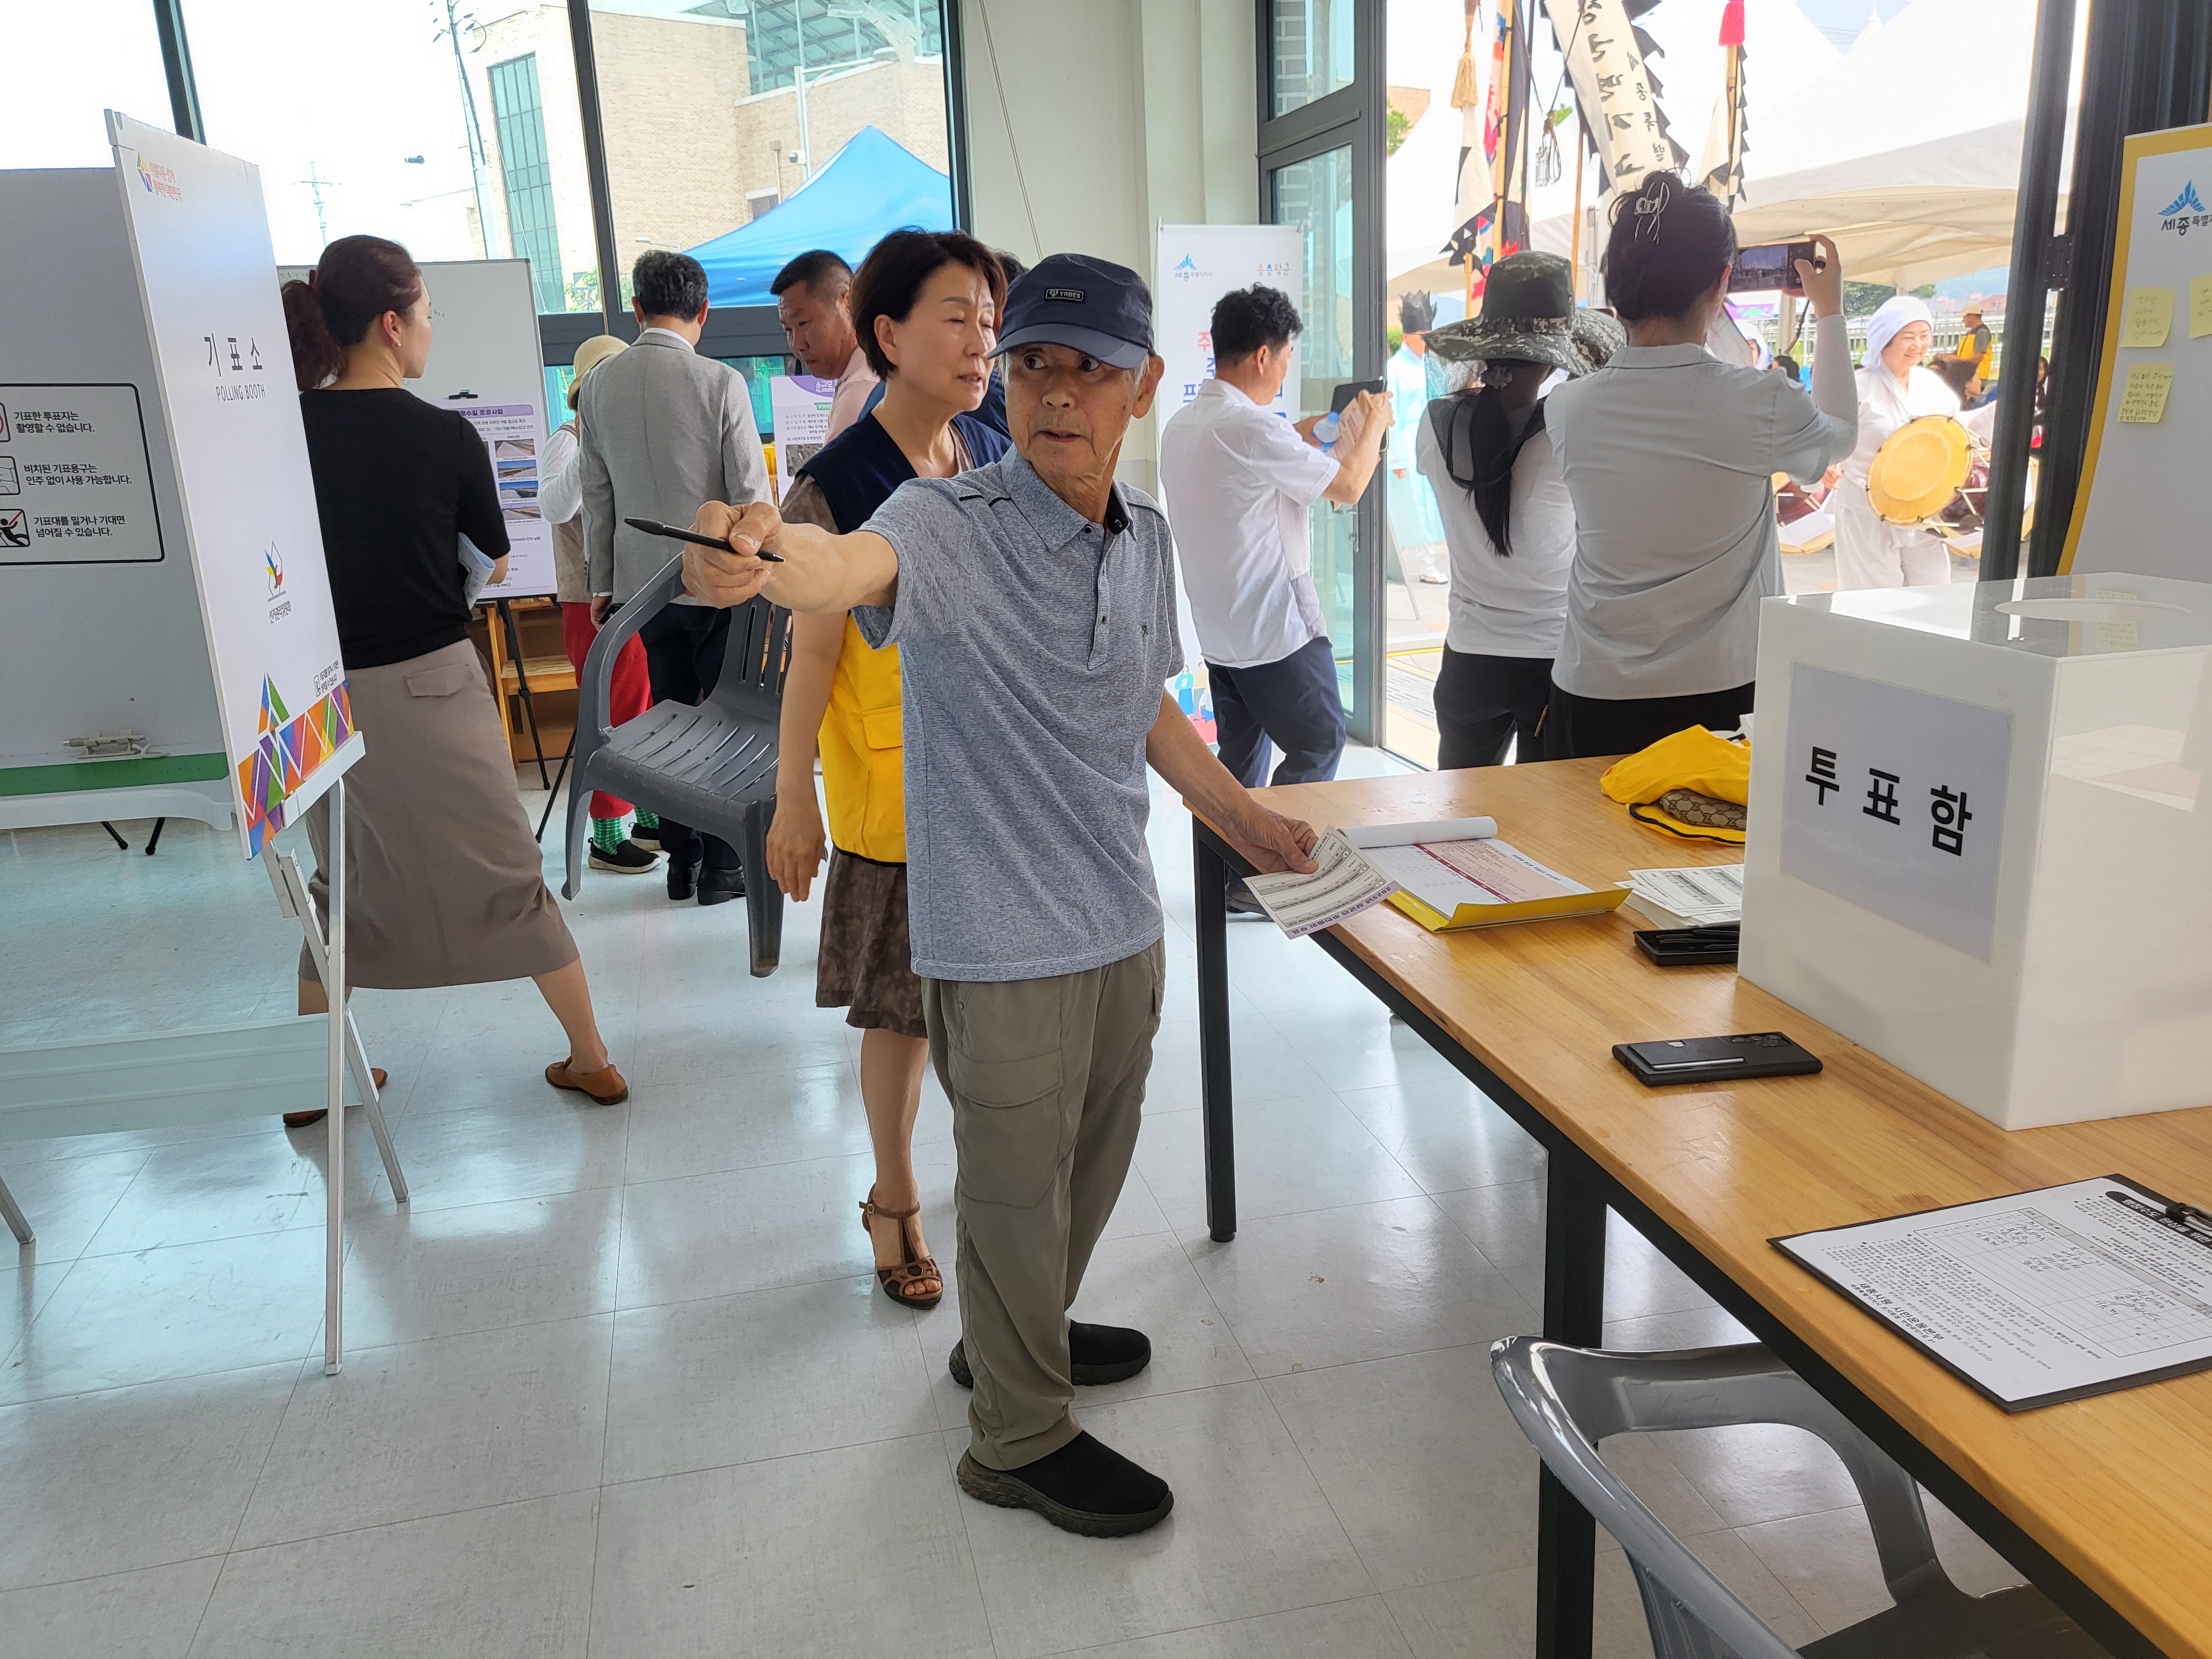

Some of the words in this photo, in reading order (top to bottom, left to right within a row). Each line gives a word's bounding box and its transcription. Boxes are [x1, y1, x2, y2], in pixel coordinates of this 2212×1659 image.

[150, 162, 167, 181] 아름다운
[166, 168, 176, 184] 선거
[153, 180, 167, 197] 행복한
[166, 184, 182, 202] 대한민국
[216, 384, 244, 401] POLLING
[244, 383, 266, 399] BOOTH
[14, 411, 41, 421] 기표한
[43, 411, 80, 421] 투표지는
[17, 423, 44, 434] 촬영할
[45, 424, 55, 433] 수
[56, 423, 95, 433] 없습니다.
[24, 464, 52, 474] 비치된
[53, 463, 98, 474] 기표용구는
[26, 476, 45, 486] 인주
[46, 476, 65, 486] 없이
[66, 476, 84, 485] 사용
[86, 474, 132, 485] 가능합니다.
[34, 516, 70, 526] 기표대를
[71, 515, 98, 525] 밀거나
[100, 515, 126, 525] 기대면
[36, 528, 63, 538] 넘어질
[64, 528, 74, 538] 수
[75, 527, 113, 538] 있습니다.
[269, 599, 292, 624] 선거관리위원회
[1366, 886, 1392, 904] 2025년
[1341, 903, 1365, 917] 장군면
[1309, 914, 1341, 928] 주민총회
[1291, 926, 1308, 935] 투표
[2120, 1199, 2163, 1217] 행정수도
[2156, 1217, 2193, 1232] 완성을
[1855, 1282, 1894, 1305] 세종사랑
[1890, 1306, 1946, 1340] 시민운동본부
